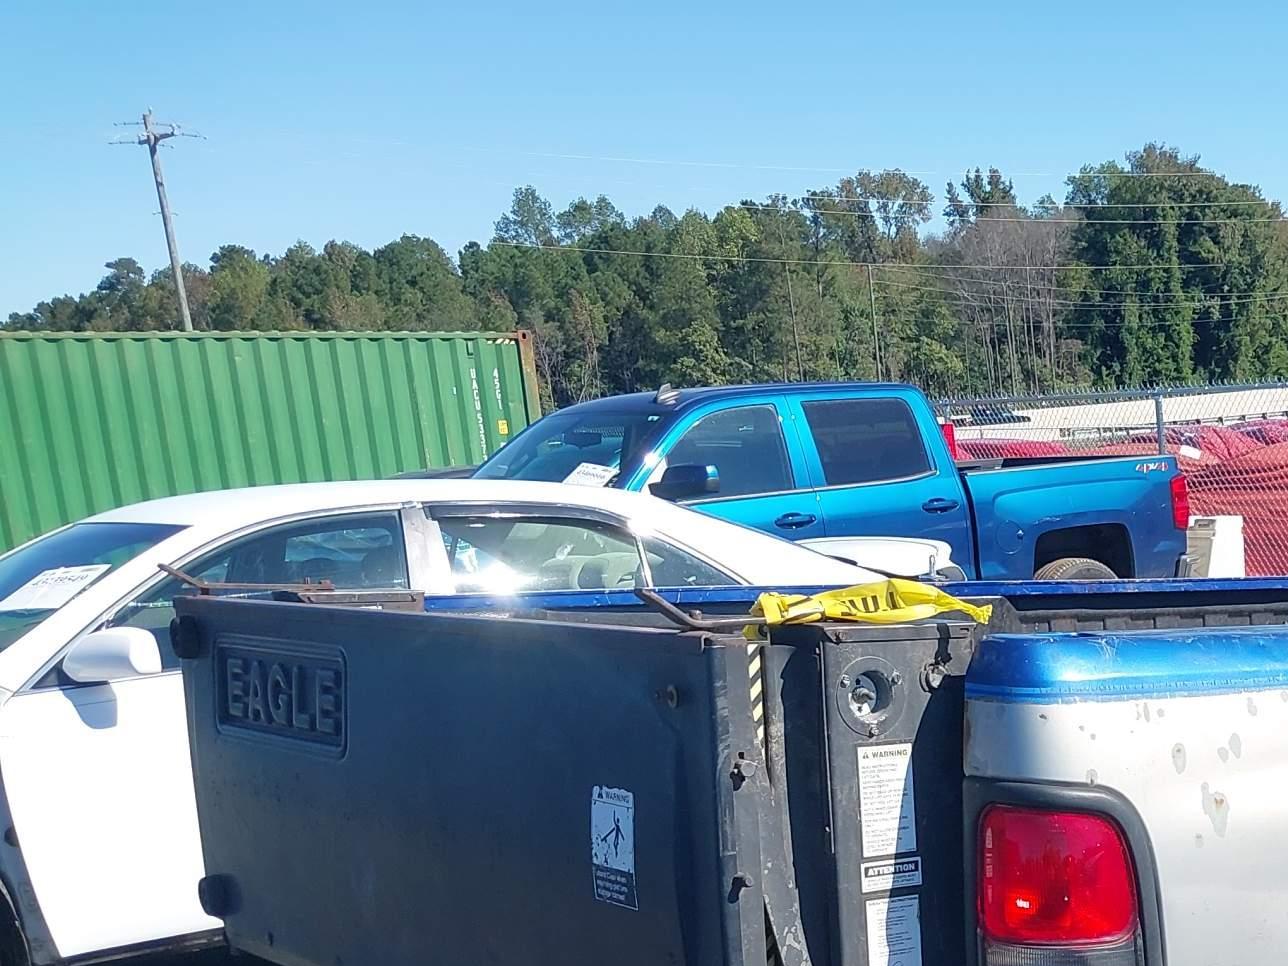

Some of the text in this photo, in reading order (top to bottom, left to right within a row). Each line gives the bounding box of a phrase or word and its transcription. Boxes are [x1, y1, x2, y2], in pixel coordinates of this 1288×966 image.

[226, 657, 338, 734] EAGLE
[871, 749, 909, 759] WARNING
[867, 863, 916, 877] ATTENTION
